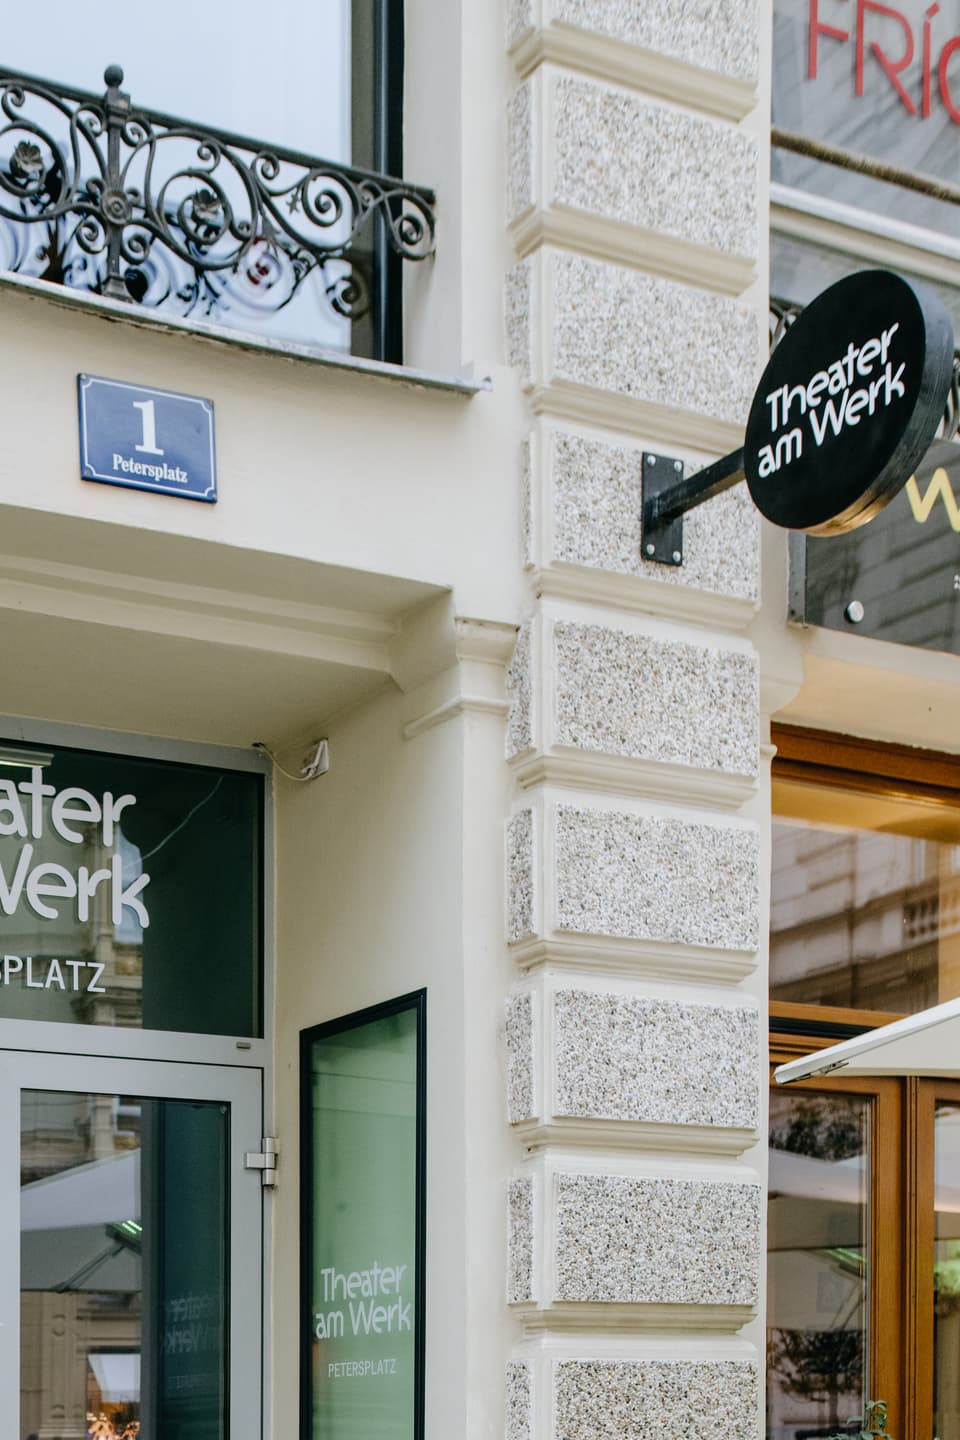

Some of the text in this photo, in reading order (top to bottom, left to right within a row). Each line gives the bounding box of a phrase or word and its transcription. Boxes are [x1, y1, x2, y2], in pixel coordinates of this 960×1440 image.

[766, 322, 899, 432] Theater
[133, 399, 164, 456] 1
[758, 361, 906, 478] am Werk
[112, 453, 189, 484] Petersplatz
[321, 1260, 407, 1302] Theater
[315, 1295, 411, 1339] am Werk
[328, 1358, 397, 1377] PETERSPLATZ
